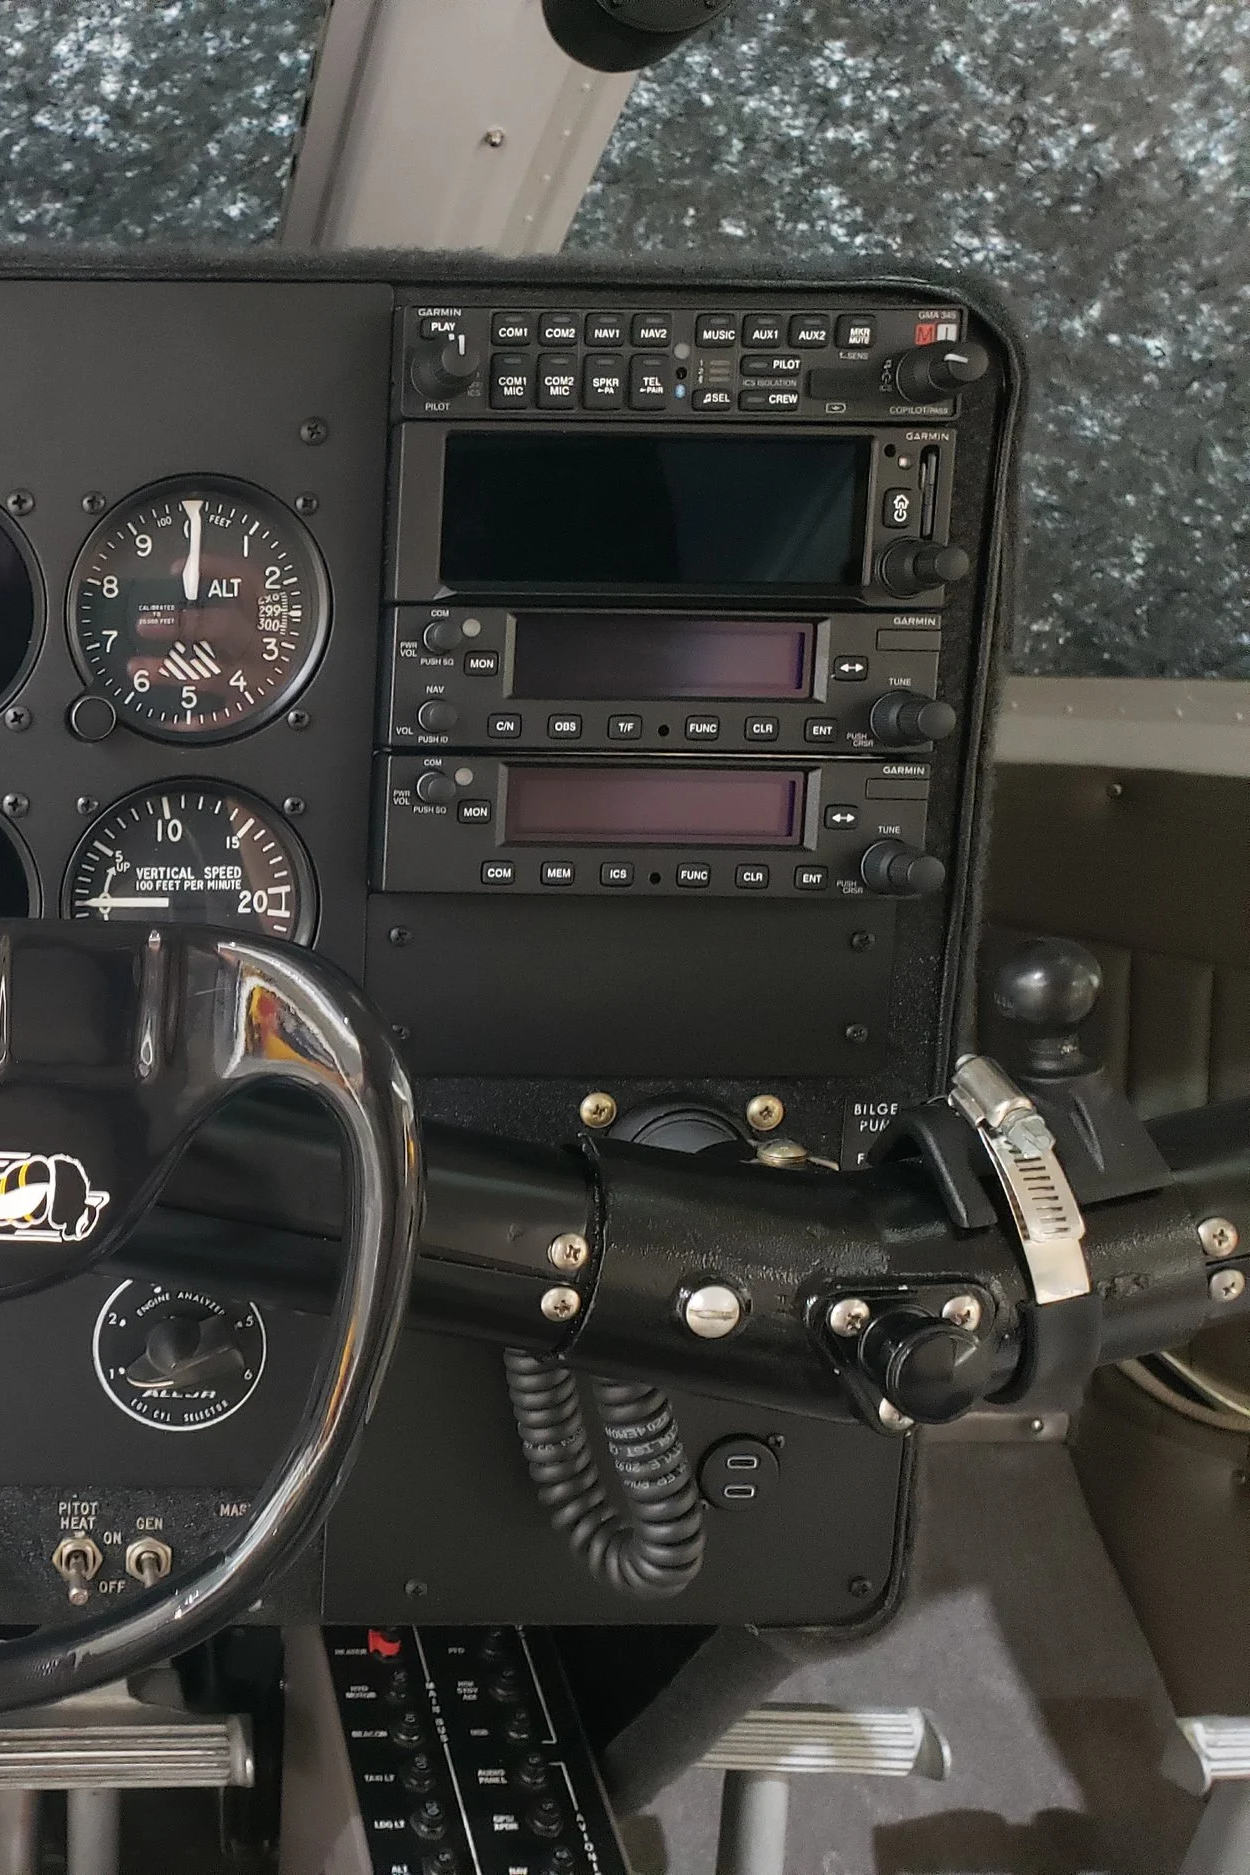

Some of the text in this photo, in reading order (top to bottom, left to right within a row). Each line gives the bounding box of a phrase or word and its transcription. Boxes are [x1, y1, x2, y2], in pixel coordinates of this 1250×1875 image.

[418, 308, 462, 317] GARMIN
[431, 322, 456, 332] PLAY
[498, 327, 528, 337] COM1
[545, 328, 575, 338] COM2
[594, 329, 620, 339] NAV1
[640, 329, 667, 339] NAV2
[703, 330, 735, 340] MUSIC
[752, 330, 778, 340] AUX1
[798, 330, 826, 341] AUX2
[773, 360, 800, 369] PILOT
[498, 377, 527, 386] COM1
[544, 376, 574, 386] COM2
[592, 378, 619, 388] SPKR
[643, 377, 661, 386] TEL
[504, 386, 524, 396] MIC
[550, 386, 570, 396] MIC
[769, 394, 798, 404] CREW
[425, 402, 450, 411] PILOT
[906, 432, 949, 441] GARMIN
[209, 514, 232, 528] FEET
[135, 534, 153, 557] 9
[207, 578, 242, 598] ALT
[431, 609, 449, 617] COM
[893, 617, 936, 626] GARMIN
[470, 659, 494, 669] MON
[888, 678, 911, 686] TUNE
[426, 685, 444, 693] NAV
[396, 727, 413, 735] VOL
[554, 722, 576, 732] OBS
[689, 724, 717, 733] FUNC
[812, 725, 833, 735] ENT
[882, 766, 925, 775] GARMIN
[464, 807, 487, 817] MON
[156, 818, 183, 843] 10
[878, 826, 900, 834] TUNE
[226, 836, 240, 849] 15
[115, 850, 123, 863] 5
[116, 862, 131, 873] UP
[136, 866, 242, 880] VERTICAL SPEED
[487, 868, 511, 878] COM
[547, 868, 571, 878] MEM
[609, 869, 627, 879] ICS
[681, 870, 708, 880] FUNC
[802, 873, 822, 883] ENT
[136, 879, 242, 891] 100 FEET PER MINUTE
[237, 890, 268, 914] 20
[854, 1103, 898, 1116] BILGE
[136, 1292, 227, 1317] ENGINE ANALYZER
[183, 1399, 229, 1422] SELECTOR
[58, 1502, 98, 1515] PITOT
[60, 1516, 96, 1530] HEAT
[136, 1517, 163, 1530] GEN
[103, 1531, 122, 1545] ON
[99, 1580, 126, 1594] OFF
